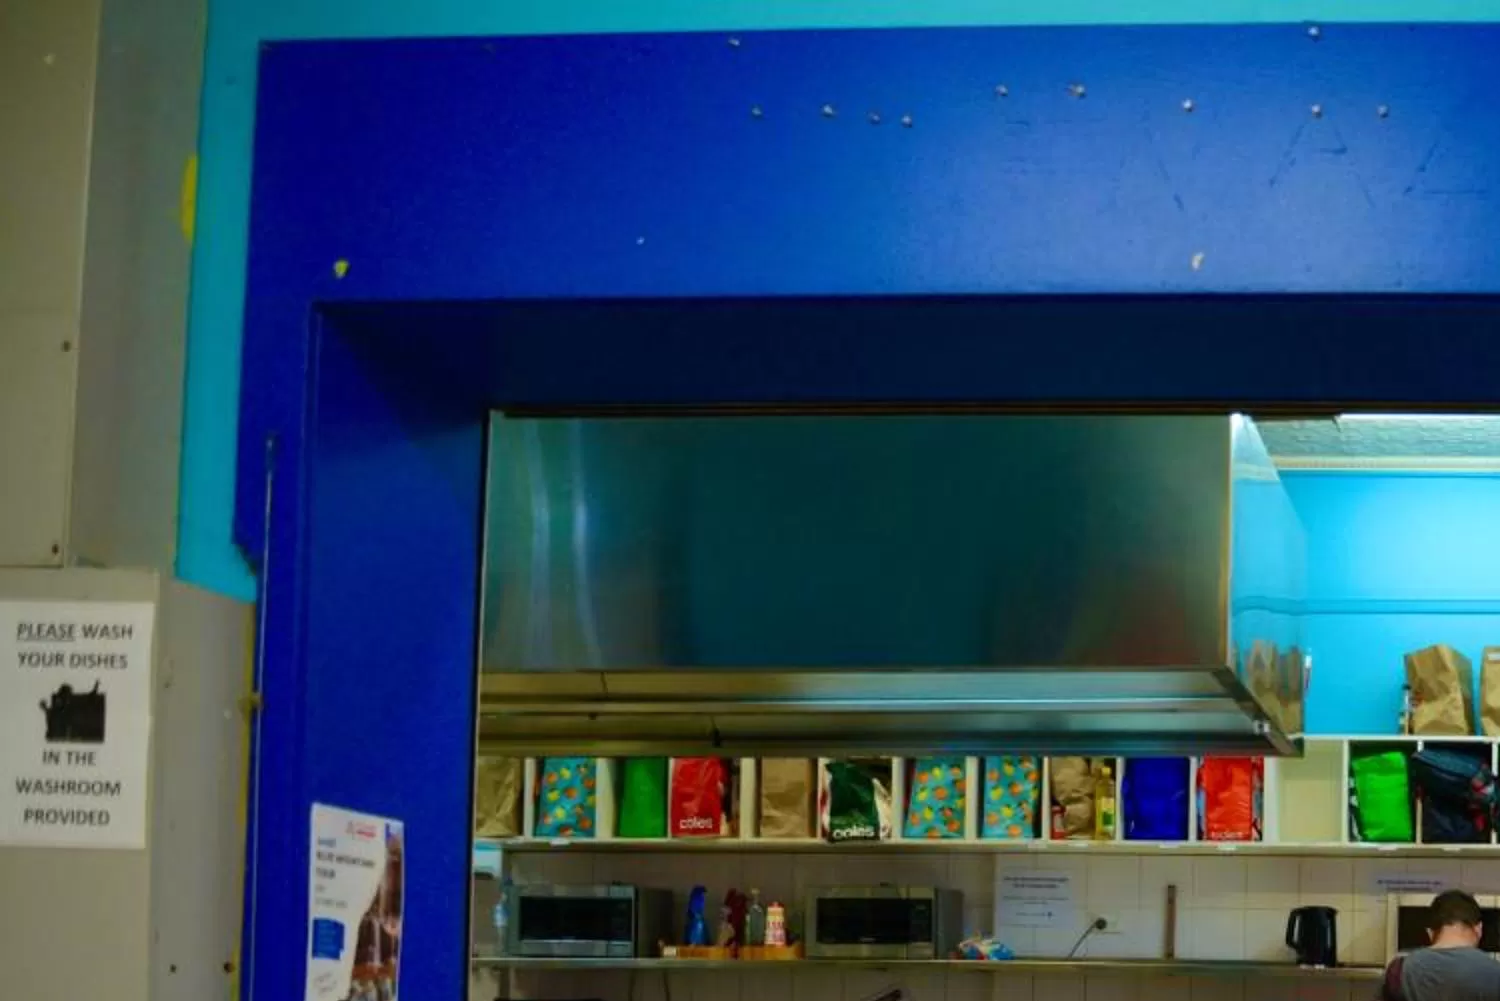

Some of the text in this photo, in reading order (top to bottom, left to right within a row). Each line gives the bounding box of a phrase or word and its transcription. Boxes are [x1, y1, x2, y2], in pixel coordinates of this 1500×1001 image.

[16, 622, 133, 641] PLEASE WASH
[17, 651, 128, 670] YOUR DISHES
[42, 750, 96, 766] IN THE
[15, 778, 121, 796] WASHROOM
[23, 808, 110, 826] PROVIDED
